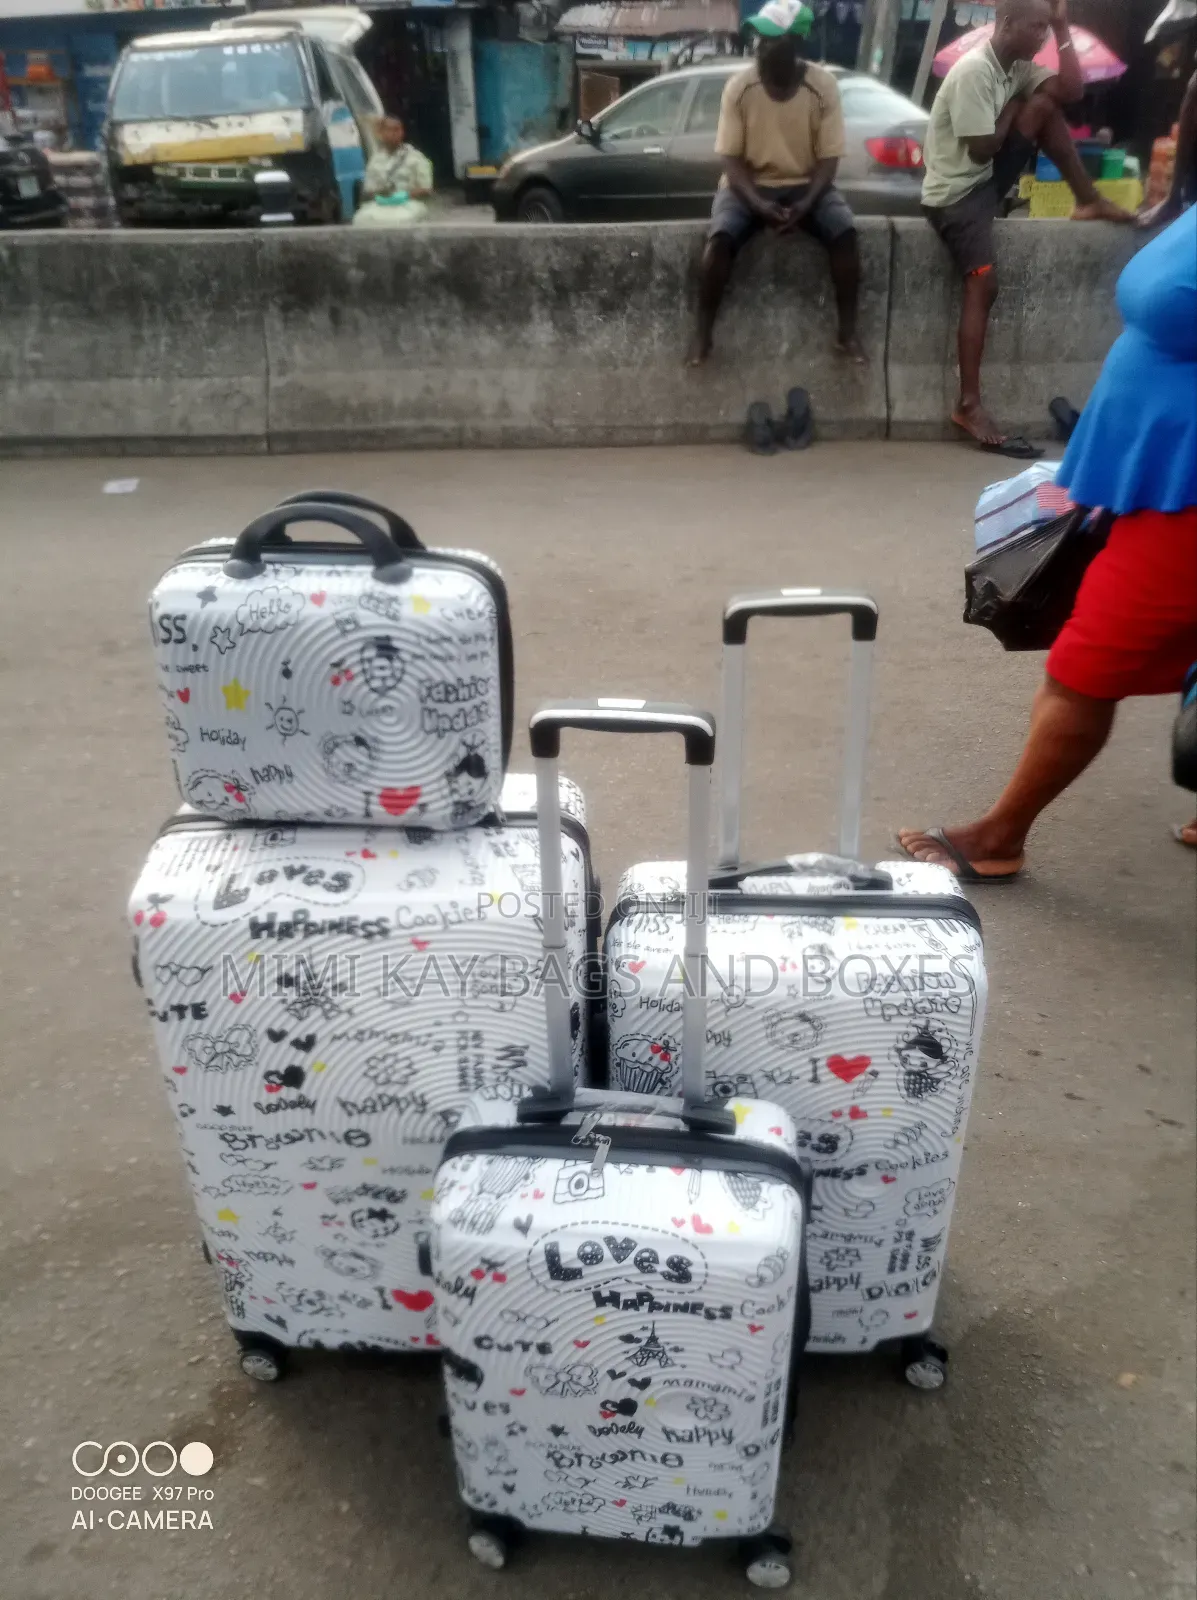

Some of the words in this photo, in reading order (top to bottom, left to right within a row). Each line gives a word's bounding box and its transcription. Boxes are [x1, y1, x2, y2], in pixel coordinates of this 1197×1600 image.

[639, 996, 683, 1013] Holida
[544, 1235, 694, 1284] Loves
[592, 1290, 733, 1320] HAPPINESS
[661, 1424, 735, 1447] happy
